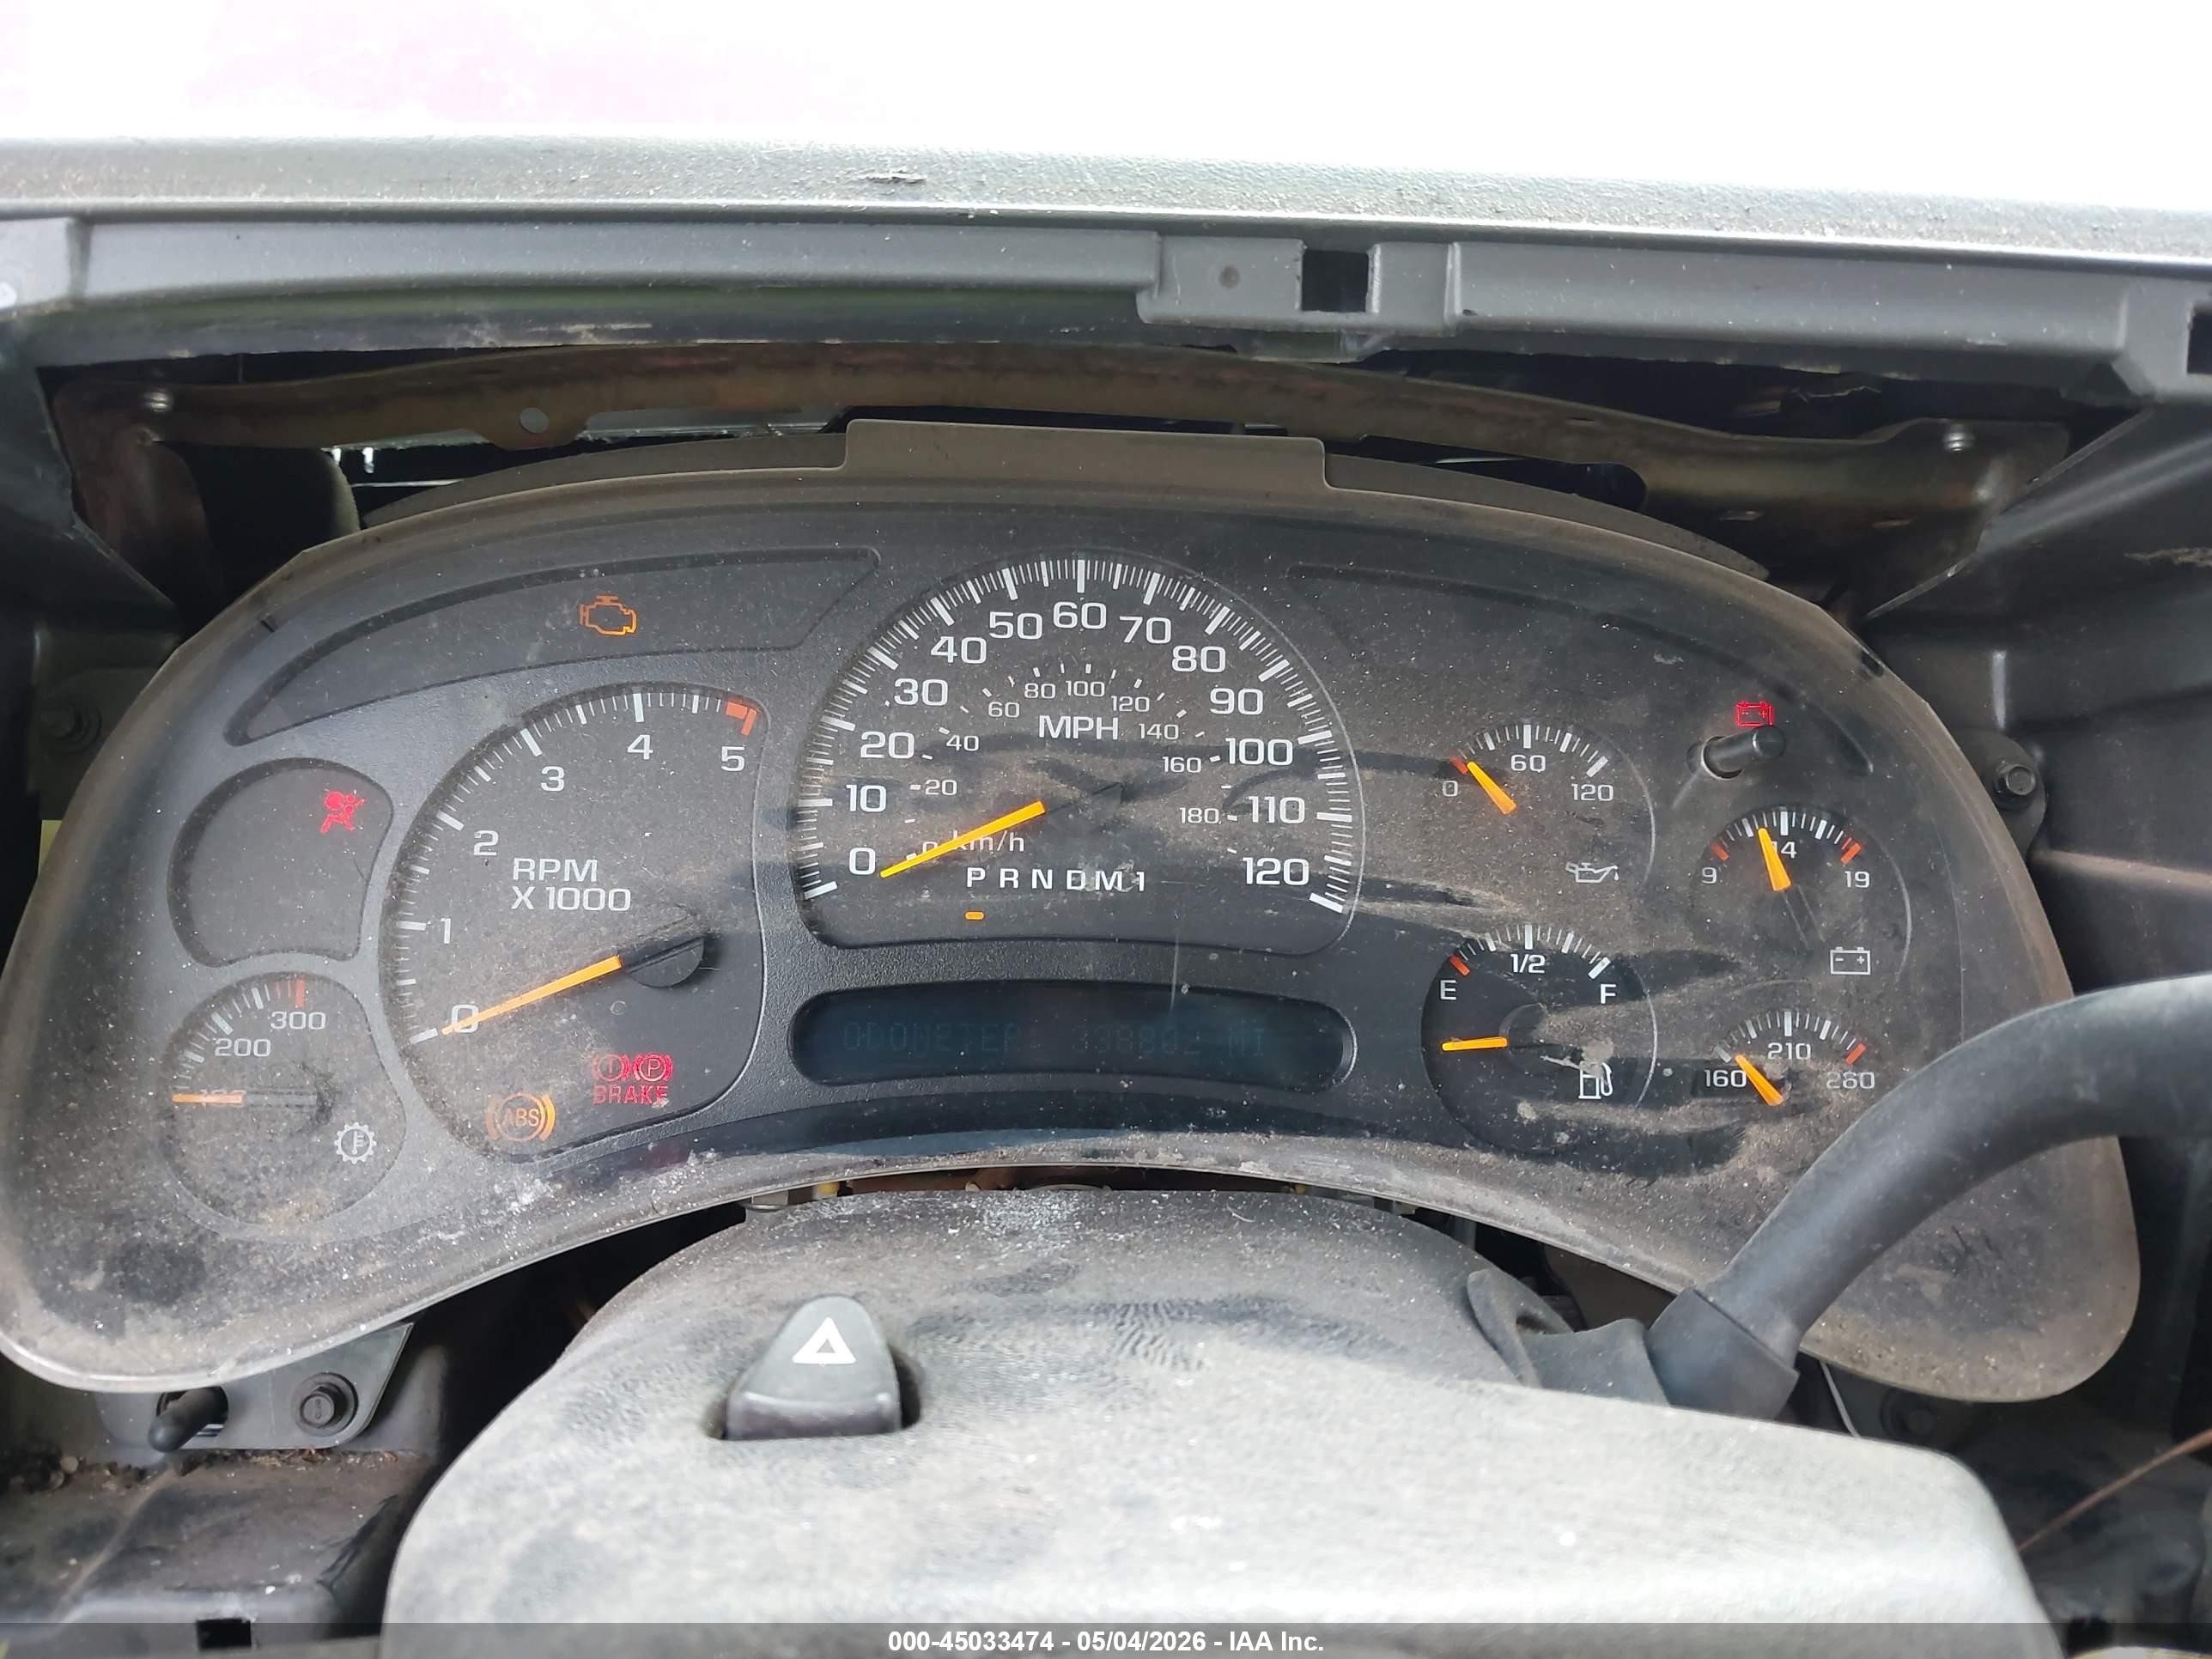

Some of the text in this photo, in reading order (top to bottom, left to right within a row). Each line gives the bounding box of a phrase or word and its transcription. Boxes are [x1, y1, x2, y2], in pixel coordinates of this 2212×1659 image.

[989, 611, 1042, 639] 50
[1054, 602, 1106, 629] 60
[1120, 617, 1170, 643] 70
[931, 636, 986, 663] 40
[1172, 646, 1225, 672] 80
[895, 678, 948, 705] 30
[1024, 684, 1055, 698] 80
[1066, 681, 1104, 696] 100
[988, 702, 1019, 717] 60
[1111, 696, 1149, 712] 120
[1211, 689, 1262, 714] 90
[1039, 715, 1118, 739] MPH
[1139, 724, 1178, 739] 140
[628, 735, 653, 759] 4
[861, 732, 914, 758] 20
[946, 735, 978, 750] 40
[1225, 738, 1292, 765] 100
[721, 746, 744, 771] 5
[1163, 757, 1201, 773] 160
[1511, 755, 1546, 772] 60
[541, 767, 564, 791] 3
[925, 780, 957, 795] 20
[1443, 781, 1458, 796] 0
[847, 785, 886, 811] 10
[1571, 784, 1613, 800] 120
[1180, 808, 1218, 823] 180
[1249, 796, 1304, 823] 110
[474, 830, 498, 855] 2
[514, 858, 597, 882] RPM
[849, 848, 875, 874] 0
[1243, 857, 1309, 884] 120
[968, 867, 1146, 891] P R N D M 1
[1703, 867, 1717, 884] 9
[1844, 872, 1869, 887] 19
[512, 886, 630, 910] X 1000
[440, 917, 452, 944] 1
[1510, 954, 1545, 973] 1/2
[1441, 981, 1456, 1000] E
[1601, 984, 1616, 1004] F
[270, 1012, 325, 1030] 300
[452, 1004, 479, 1033] 0
[216, 1038, 270, 1056] 200
[1768, 1042, 1810, 1060] 210
[1705, 1070, 1746, 1087] 160
[1826, 1071, 1875, 1089] 260
[592, 1085, 669, 1105] BRAKE
[502, 1109, 539, 1127] ABS
